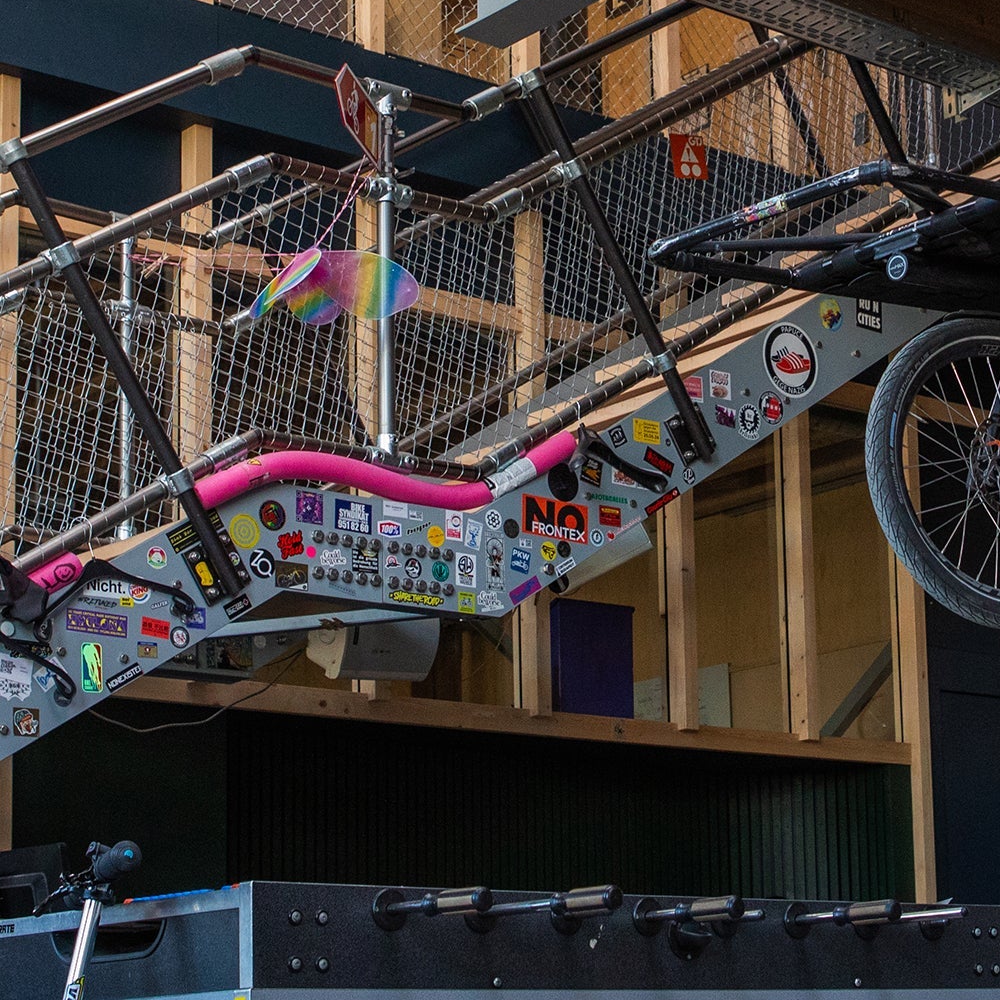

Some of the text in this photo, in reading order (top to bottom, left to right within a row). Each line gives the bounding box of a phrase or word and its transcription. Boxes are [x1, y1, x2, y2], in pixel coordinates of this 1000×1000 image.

[857, 312, 881, 330] CITIES
[338, 507, 369, 522] SYNDIKAT
[350, 502, 366, 513] BIKE
[525, 496, 586, 540] NO
[337, 519, 370, 533] 951 82 60
[380, 524, 400, 535] 100%
[531, 520, 586, 543] FRONTEX
[512, 547, 530, 561] PKW
[87, 578, 126, 594] Nicht.
[131, 584, 149, 597] KING
